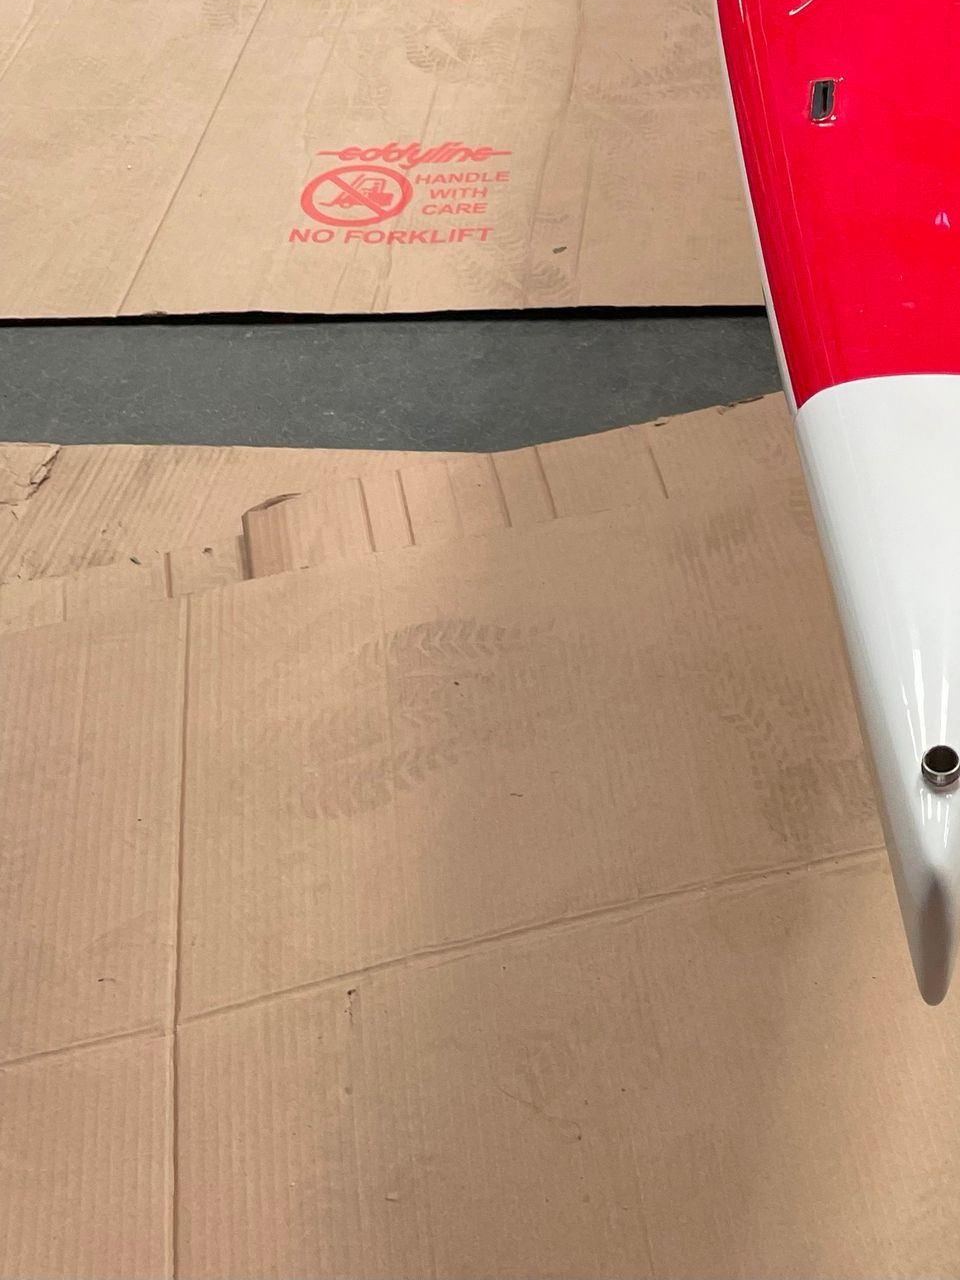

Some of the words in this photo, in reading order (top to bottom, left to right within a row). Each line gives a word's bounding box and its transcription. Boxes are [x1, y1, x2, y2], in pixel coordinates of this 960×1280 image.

[415, 171, 511, 185] HANDLE
[430, 187, 489, 199] WITH
[421, 202, 488, 215] CARE
[289, 228, 335, 243] NO
[344, 227, 494, 245] FORKLIFT
